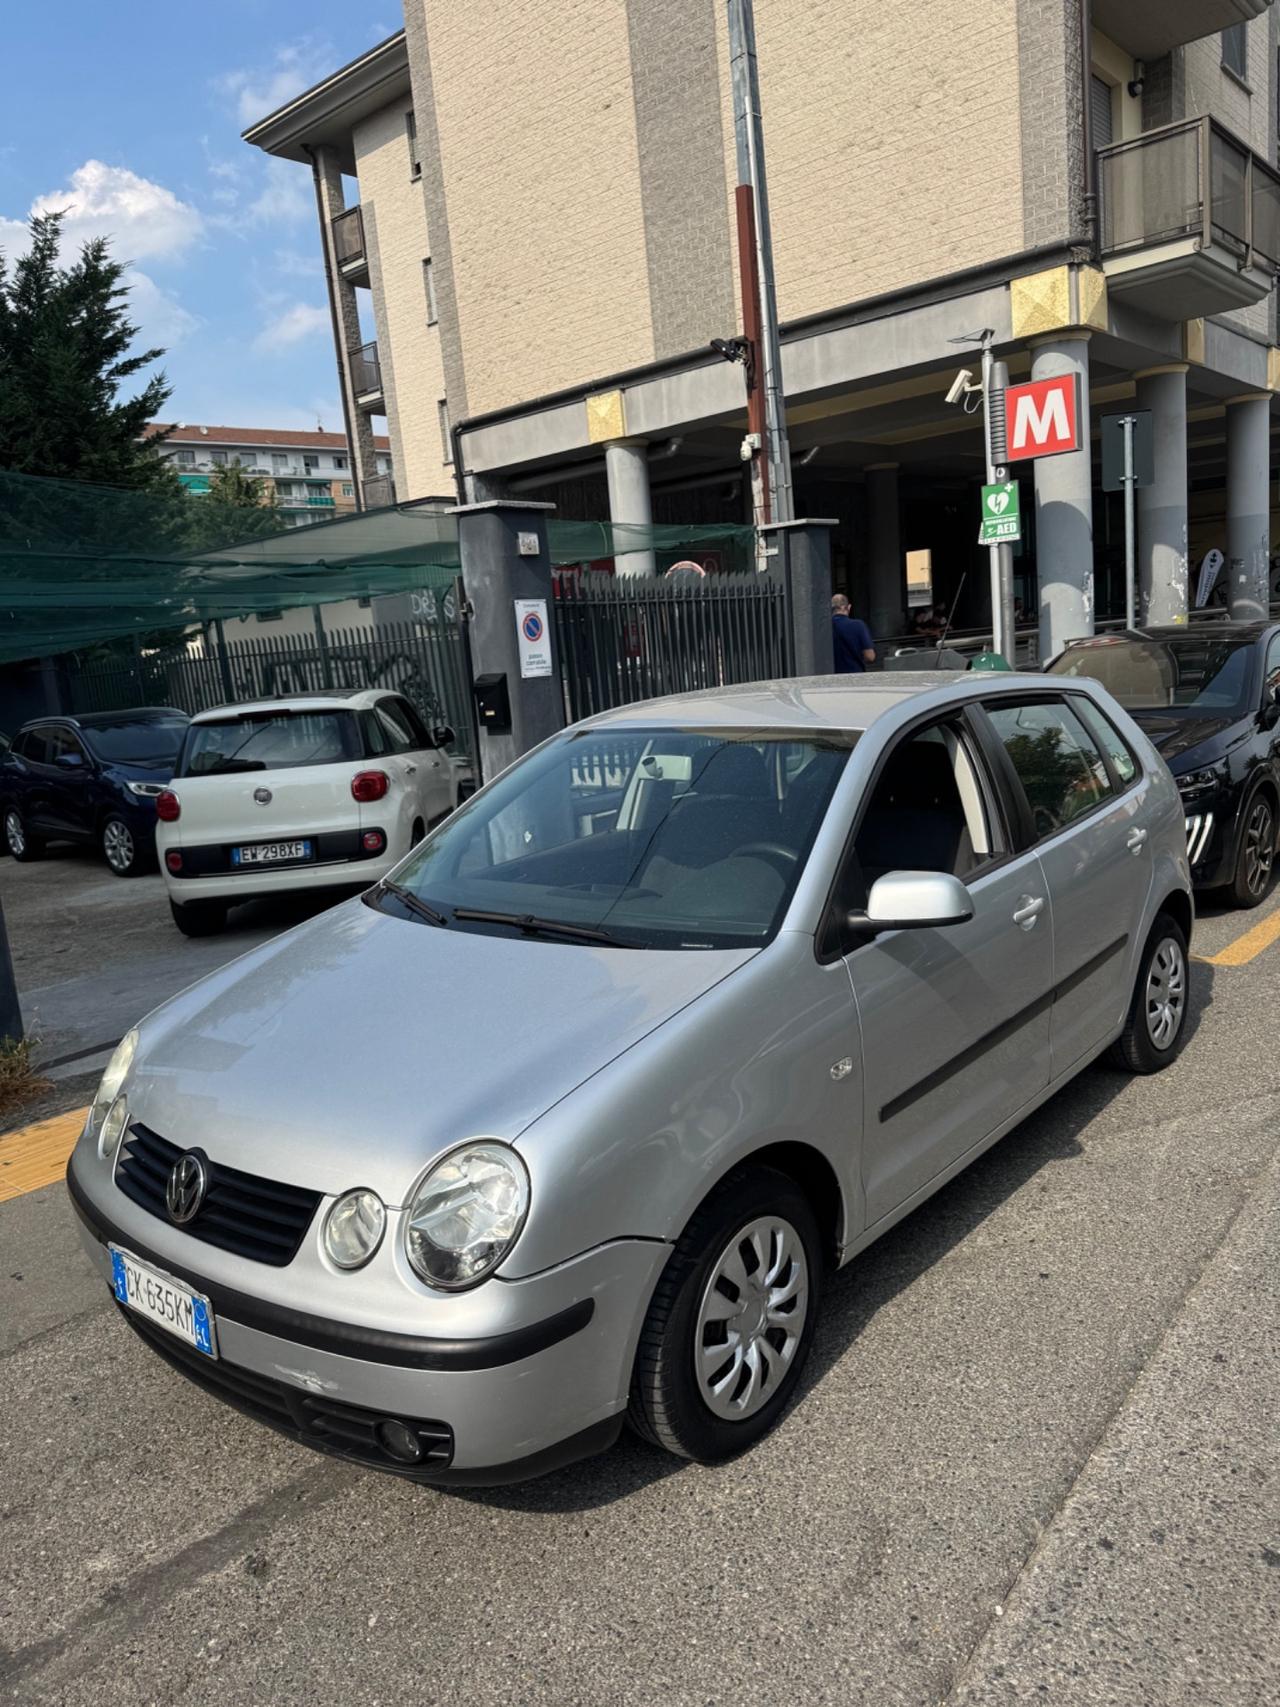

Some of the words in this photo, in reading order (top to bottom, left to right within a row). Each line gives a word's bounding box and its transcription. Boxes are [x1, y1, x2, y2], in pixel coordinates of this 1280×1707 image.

[1012, 388, 1071, 449] M
[996, 523, 1017, 535] AED
[263, 842, 302, 859] 298XF
[146, 1278, 195, 1336] 635KM
